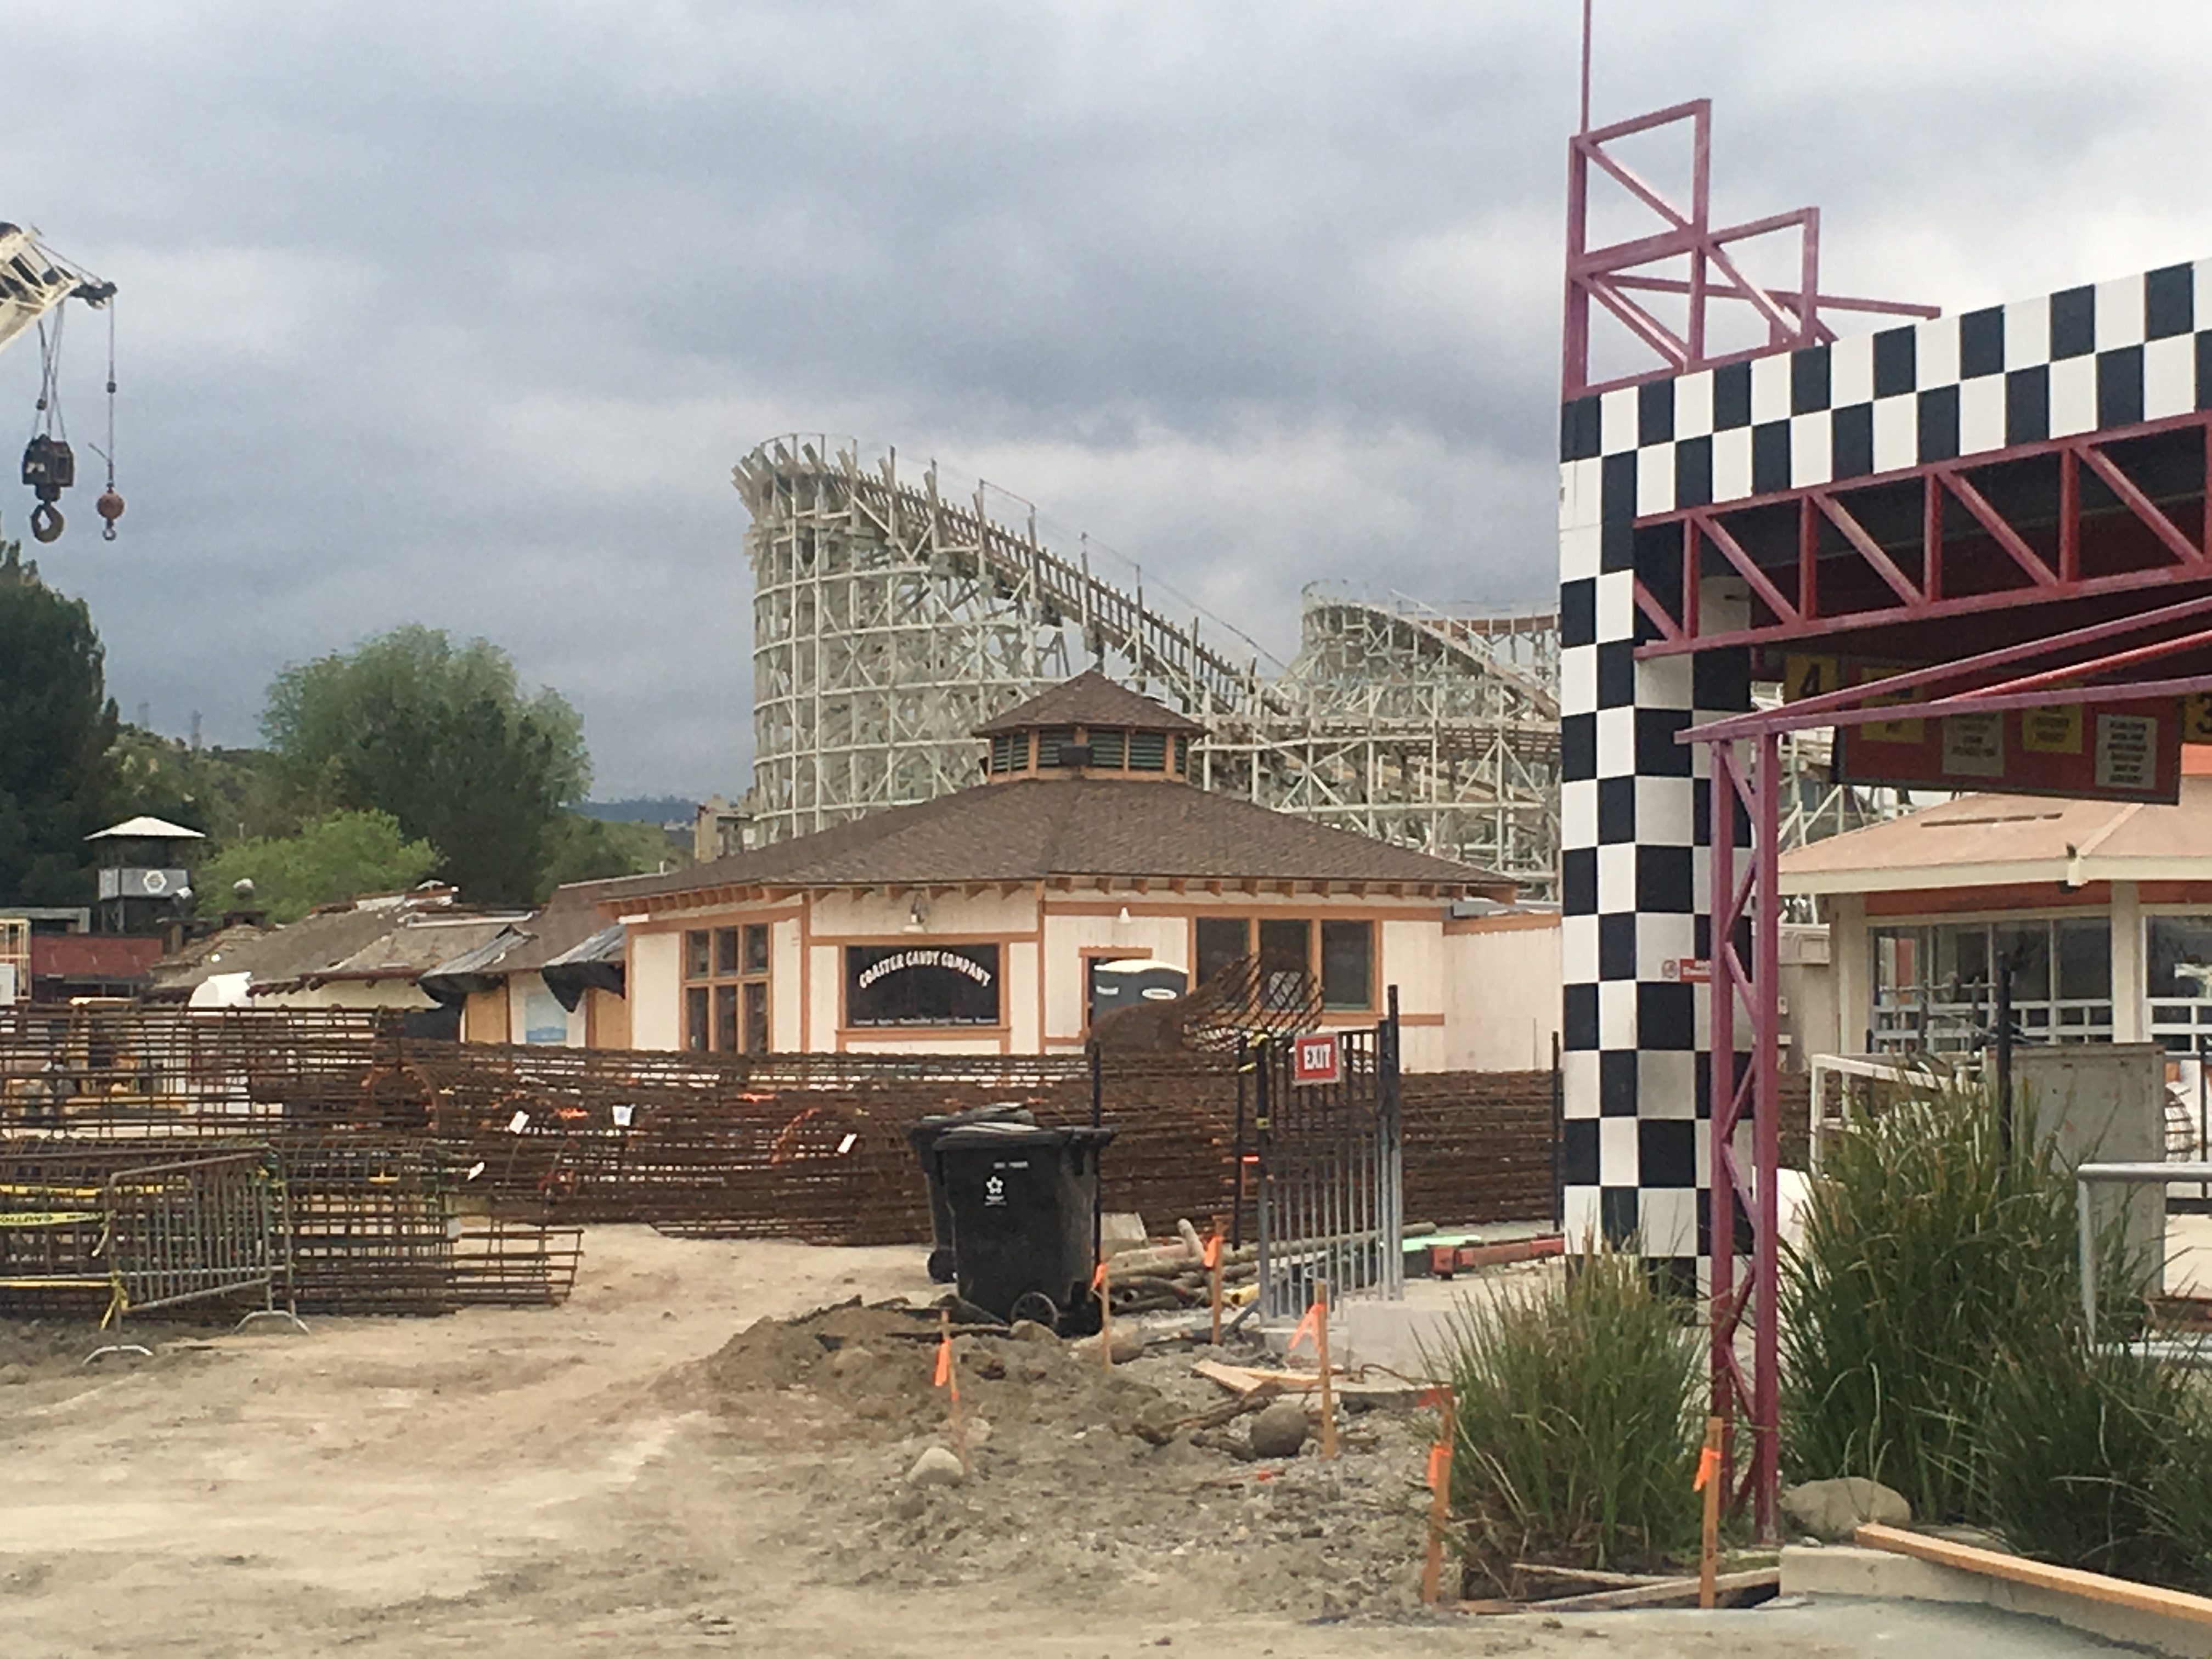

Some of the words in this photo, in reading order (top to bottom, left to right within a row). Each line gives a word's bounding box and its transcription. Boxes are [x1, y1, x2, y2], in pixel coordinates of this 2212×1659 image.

[859, 953, 904, 989] COASTER
[906, 950, 940, 966] CANDY
[941, 952, 992, 987] COMPANY
[1304, 1043, 1331, 1070] EXIT
